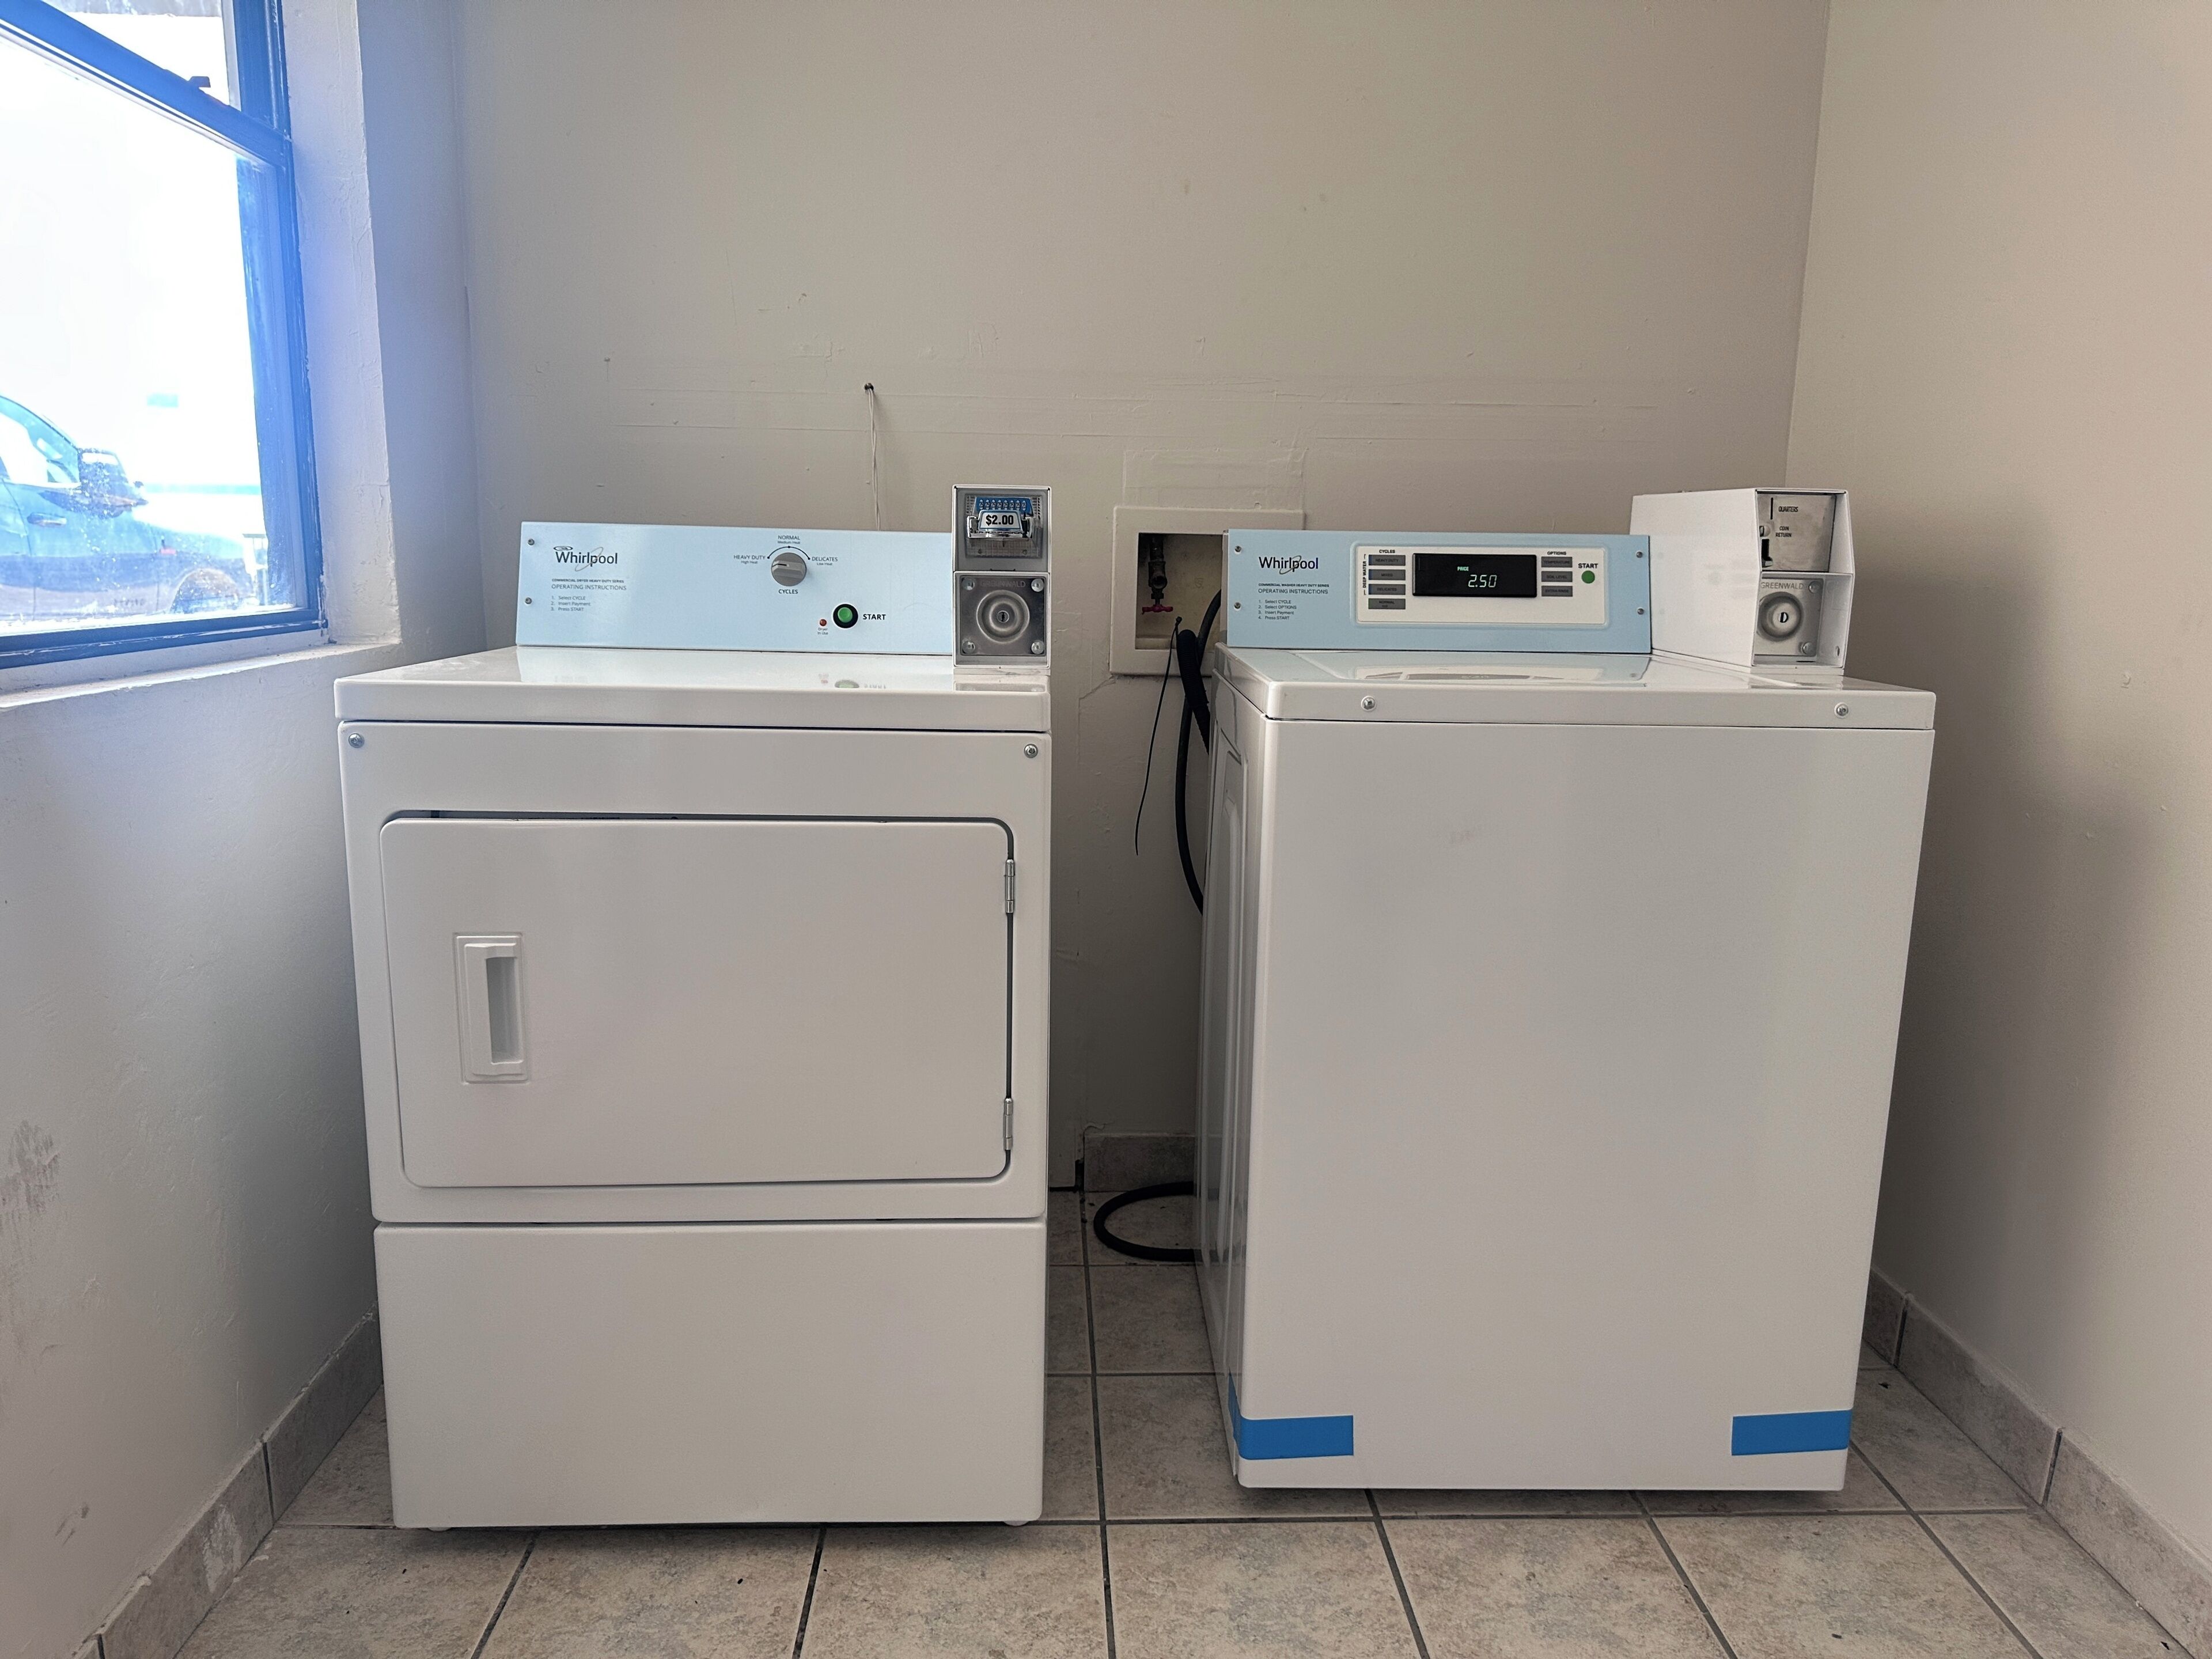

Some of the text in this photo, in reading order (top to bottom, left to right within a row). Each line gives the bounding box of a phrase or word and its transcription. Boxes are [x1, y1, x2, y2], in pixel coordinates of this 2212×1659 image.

[986, 514, 1014, 526] $2.00
[555, 551, 618, 567] Whirlpool
[1259, 556, 1319, 573] Whirlpool
[1468, 574, 1497, 588] 2.50
